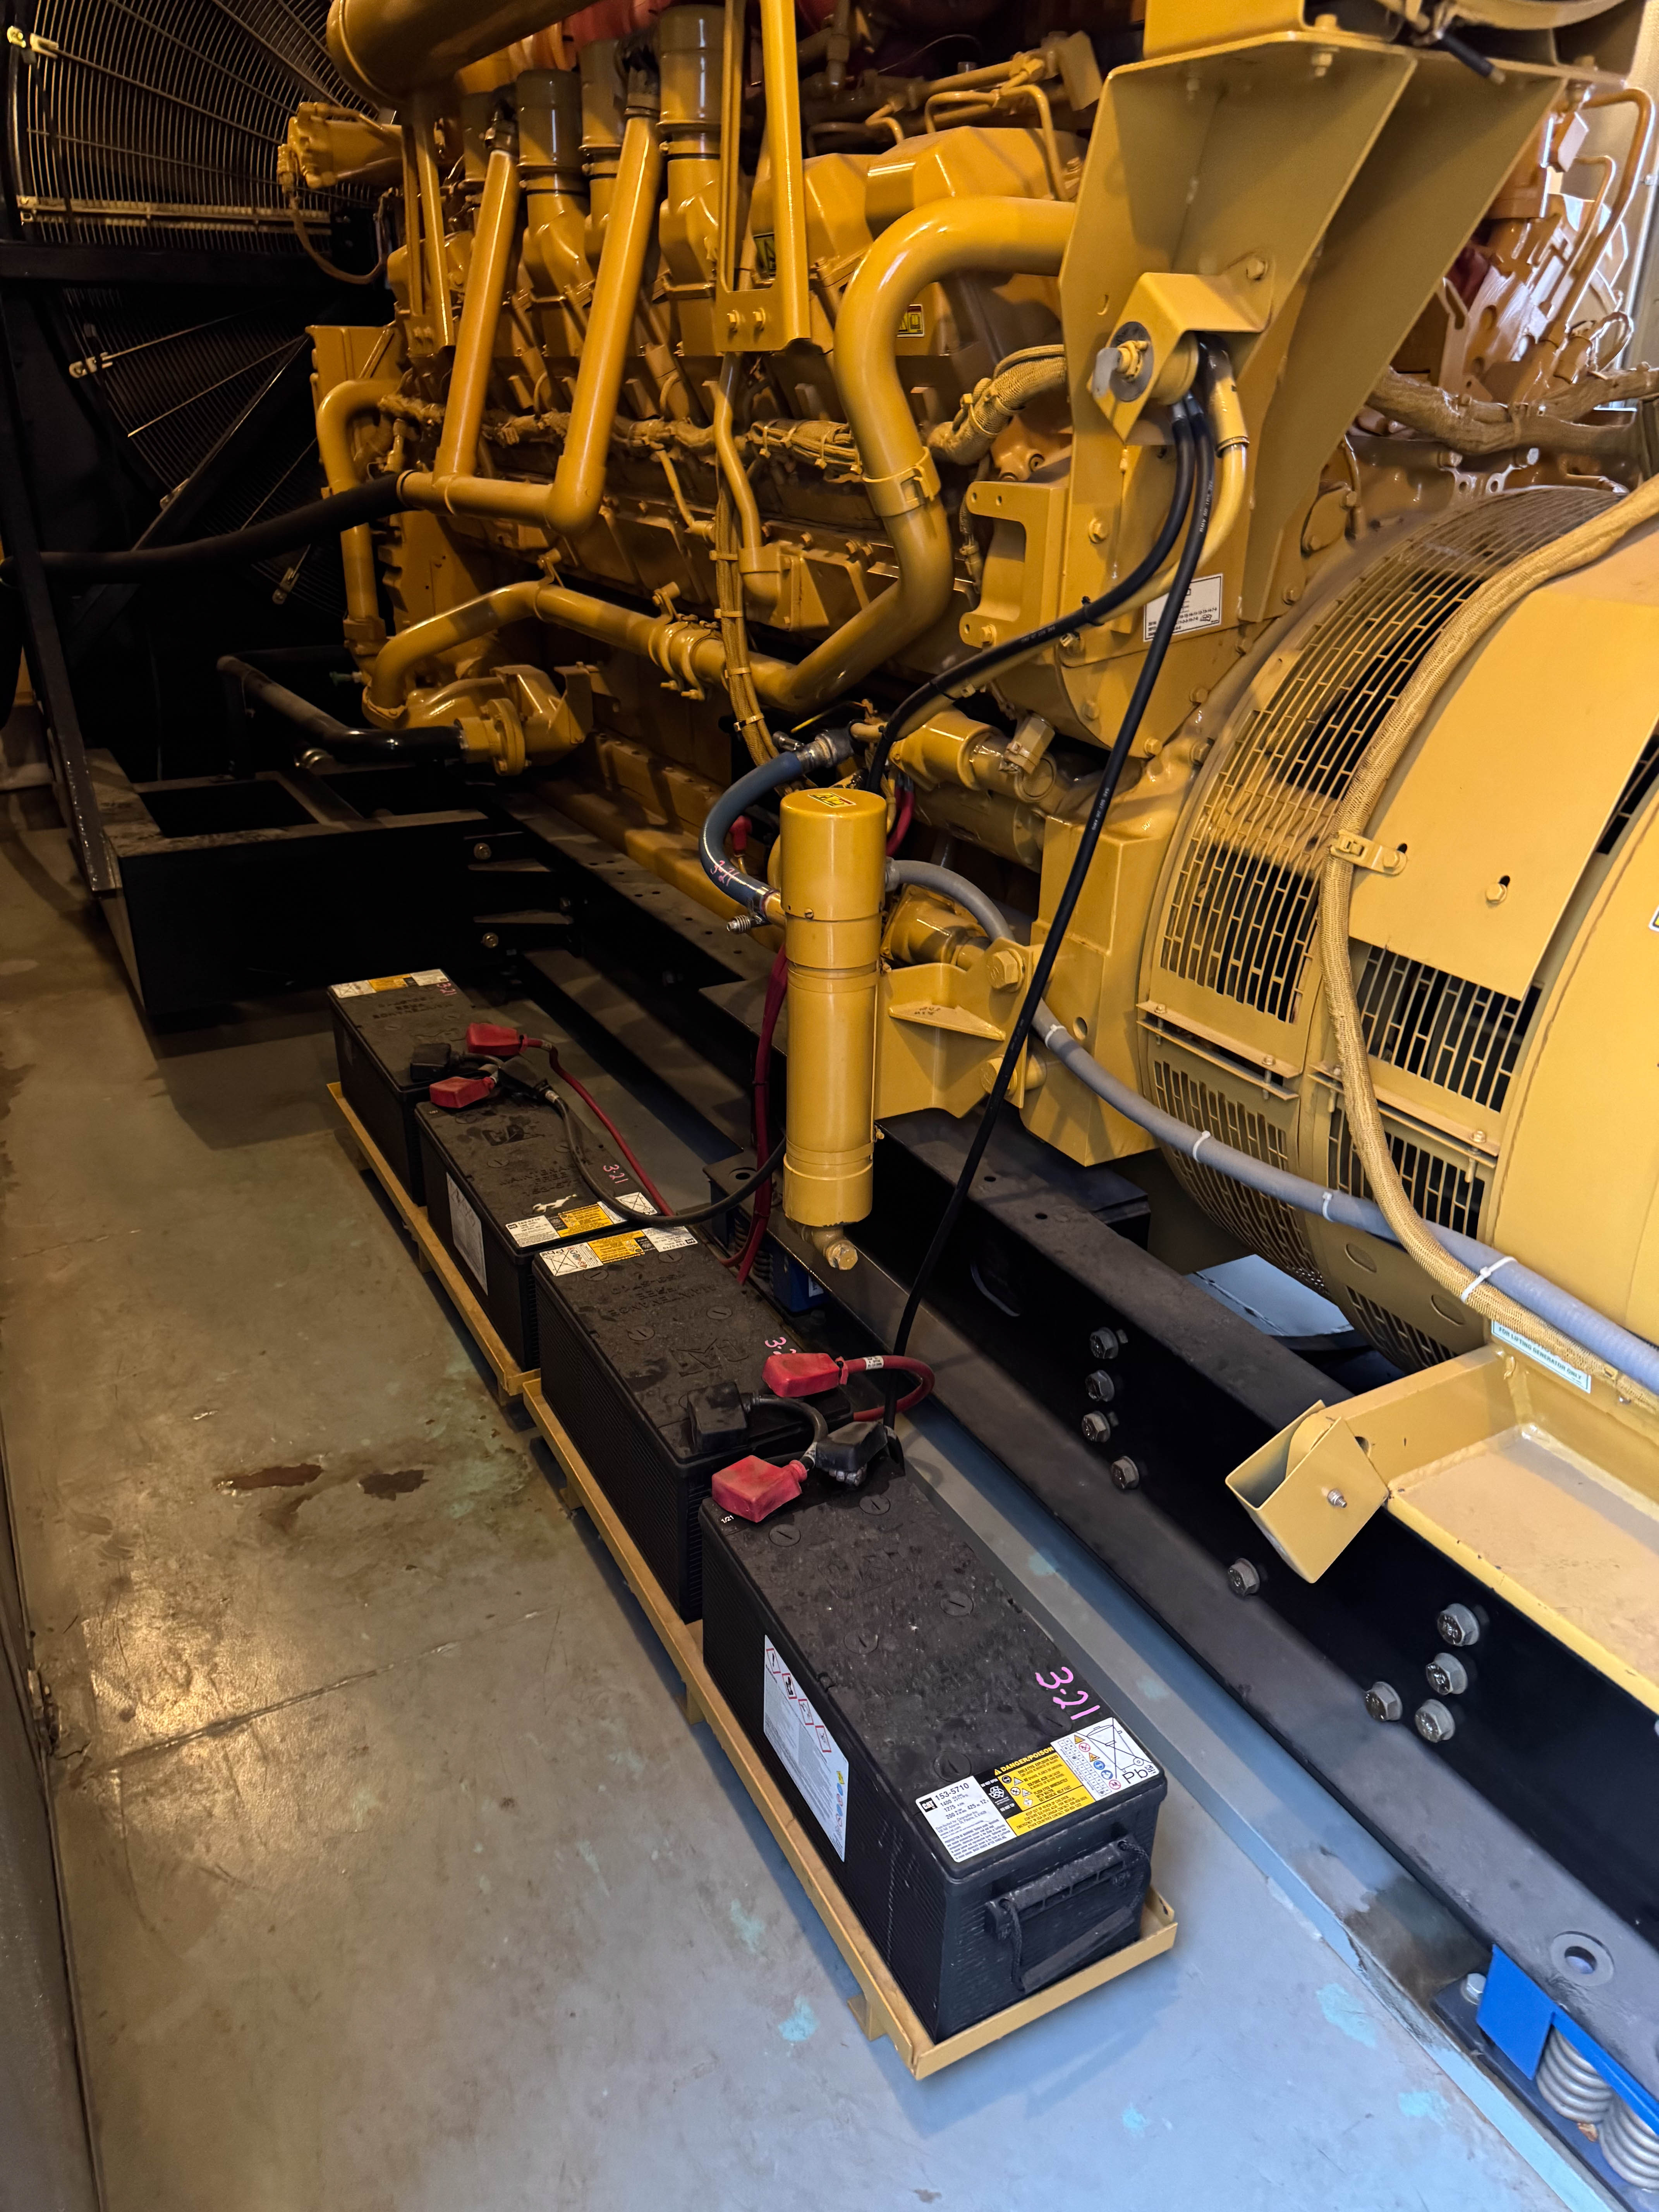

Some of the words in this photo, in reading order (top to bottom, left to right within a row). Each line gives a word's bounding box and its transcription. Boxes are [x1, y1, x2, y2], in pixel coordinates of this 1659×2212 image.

[1511, 1334, 1532, 1350] LIFTING
[1533, 1346, 1566, 1371] GENERATOR
[1567, 1367, 1582, 1379] ONLY
[721, 1515, 734, 1523] 1/21
[1000, 1746, 1054, 1772] DANGER/POISON
[1121, 1766, 1149, 1784] Pb
[921, 1800, 935, 1810] CAT
[934, 1782, 970, 1801] 153-5710
